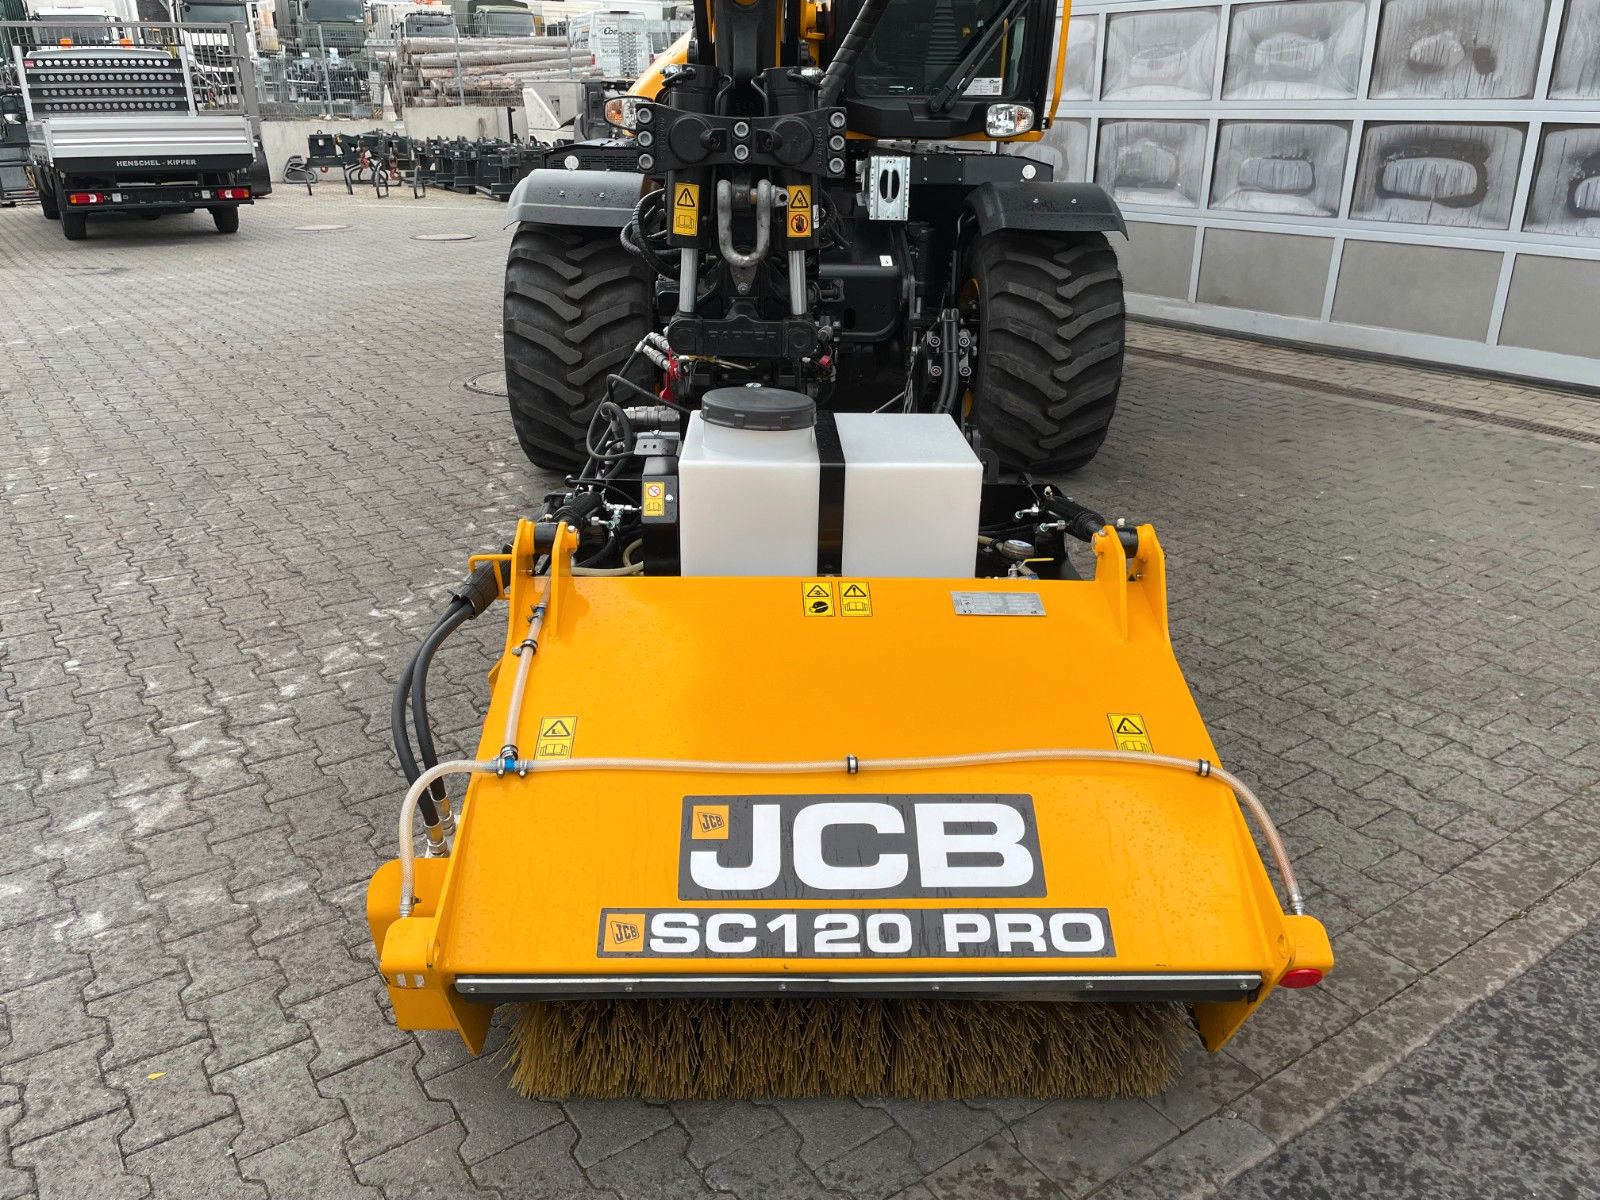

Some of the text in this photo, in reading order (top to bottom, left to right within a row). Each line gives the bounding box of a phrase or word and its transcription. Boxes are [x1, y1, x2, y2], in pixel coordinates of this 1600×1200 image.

[702, 814, 724, 831] JCB
[690, 803, 1034, 890] JCB
[615, 923, 638, 942] JCB
[650, 912, 1105, 953] SC120 PRO
